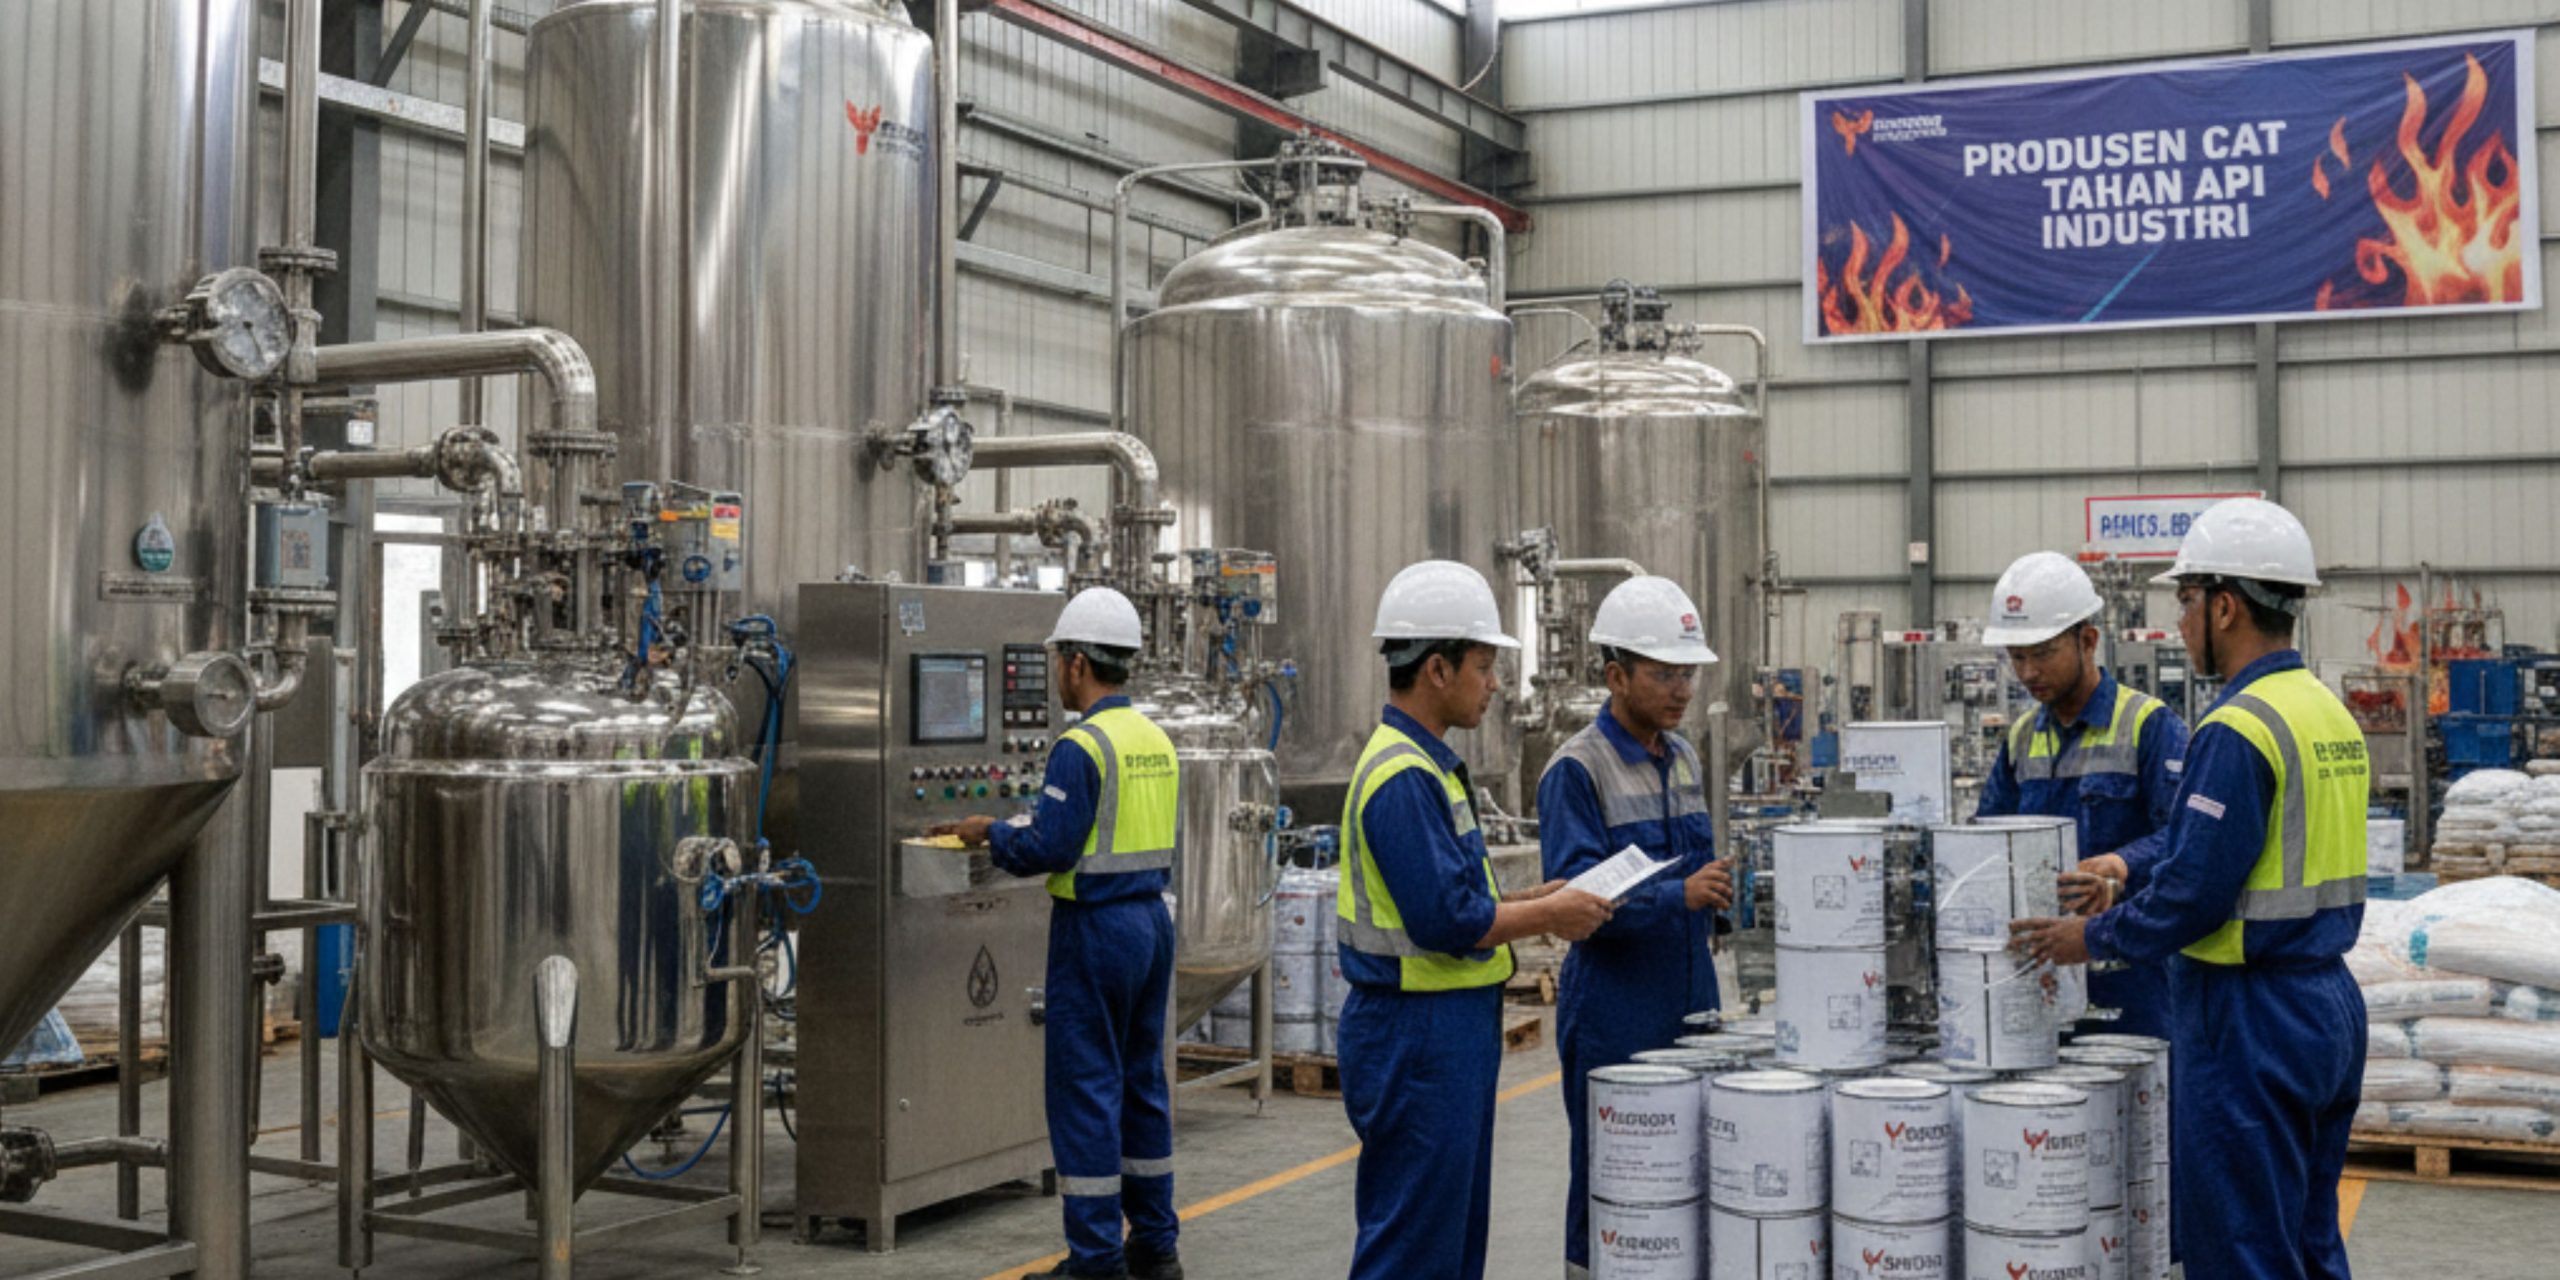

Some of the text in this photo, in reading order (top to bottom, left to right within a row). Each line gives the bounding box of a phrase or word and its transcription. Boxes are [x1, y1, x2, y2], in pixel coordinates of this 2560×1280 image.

[1963, 120, 2287, 177] PRODUSEN CAT
[2042, 165, 2265, 210] TAHAN API
